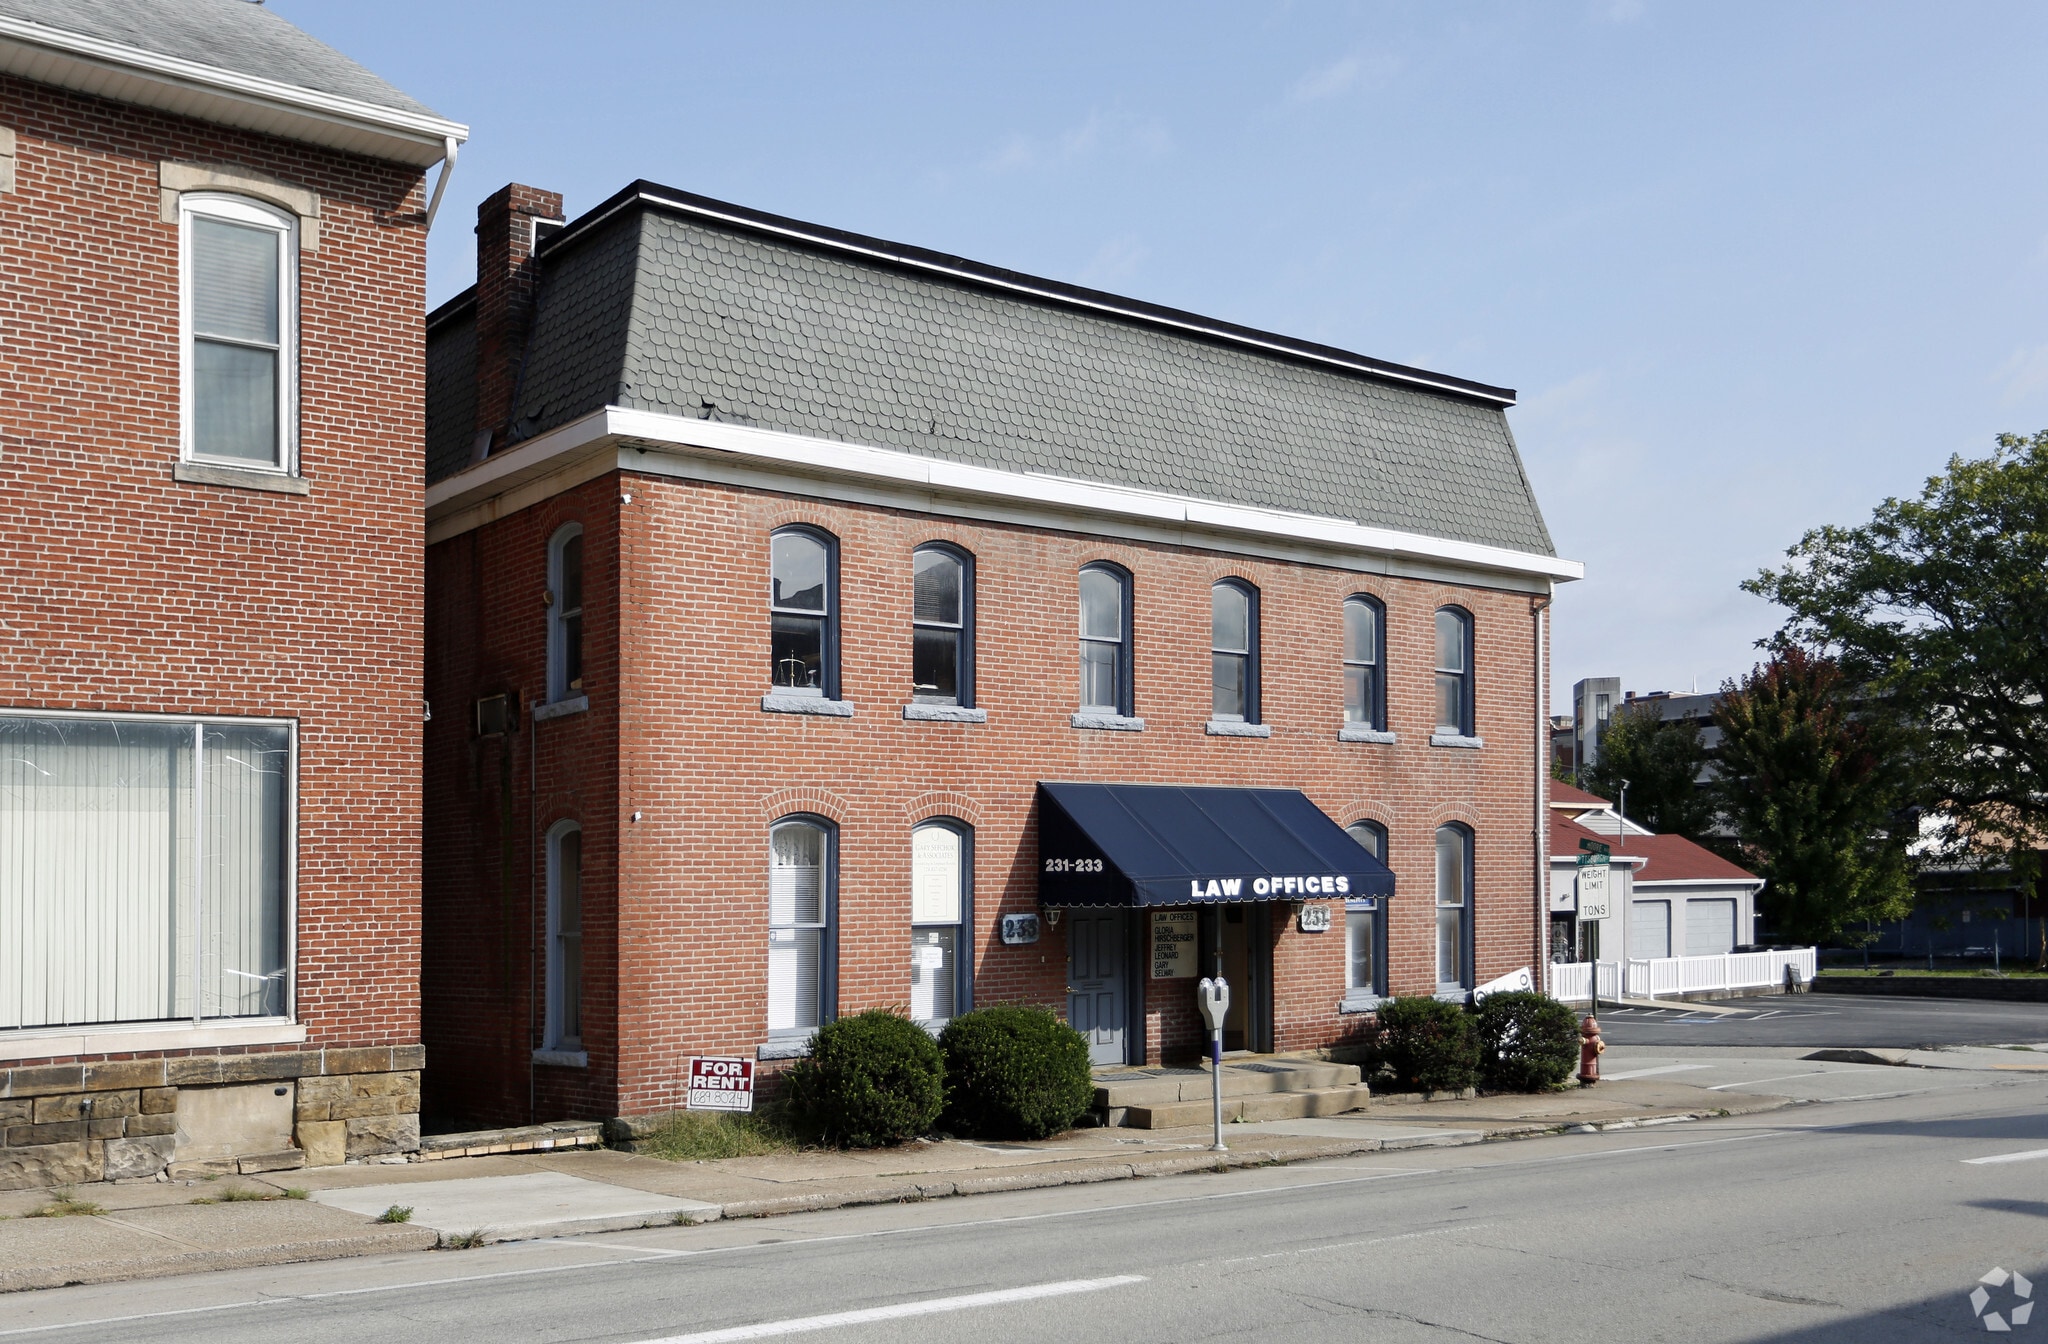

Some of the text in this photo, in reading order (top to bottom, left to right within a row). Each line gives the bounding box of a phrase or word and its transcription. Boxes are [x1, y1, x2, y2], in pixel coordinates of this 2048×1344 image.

[1045, 858, 1103, 872] 231-233
[1581, 869, 1606, 879] WEIGHT
[1191, 876, 1349, 897] LAW OFFICES
[1585, 881, 1603, 890] LIMIT
[1583, 904, 1606, 916] TONS
[1170, 913, 1194, 921] OFFICES
[1303, 908, 1329, 926] 231
[1005, 919, 1038, 938] 233
[1155, 926, 1173, 934] GLORIA
[1155, 944, 1177, 952] JEFFREY
[1155, 952, 1179, 960] LEONARD
[1155, 961, 1169, 969] GARY
[701, 1062, 743, 1076] FOR
[693, 1076, 749, 1090] RENT
